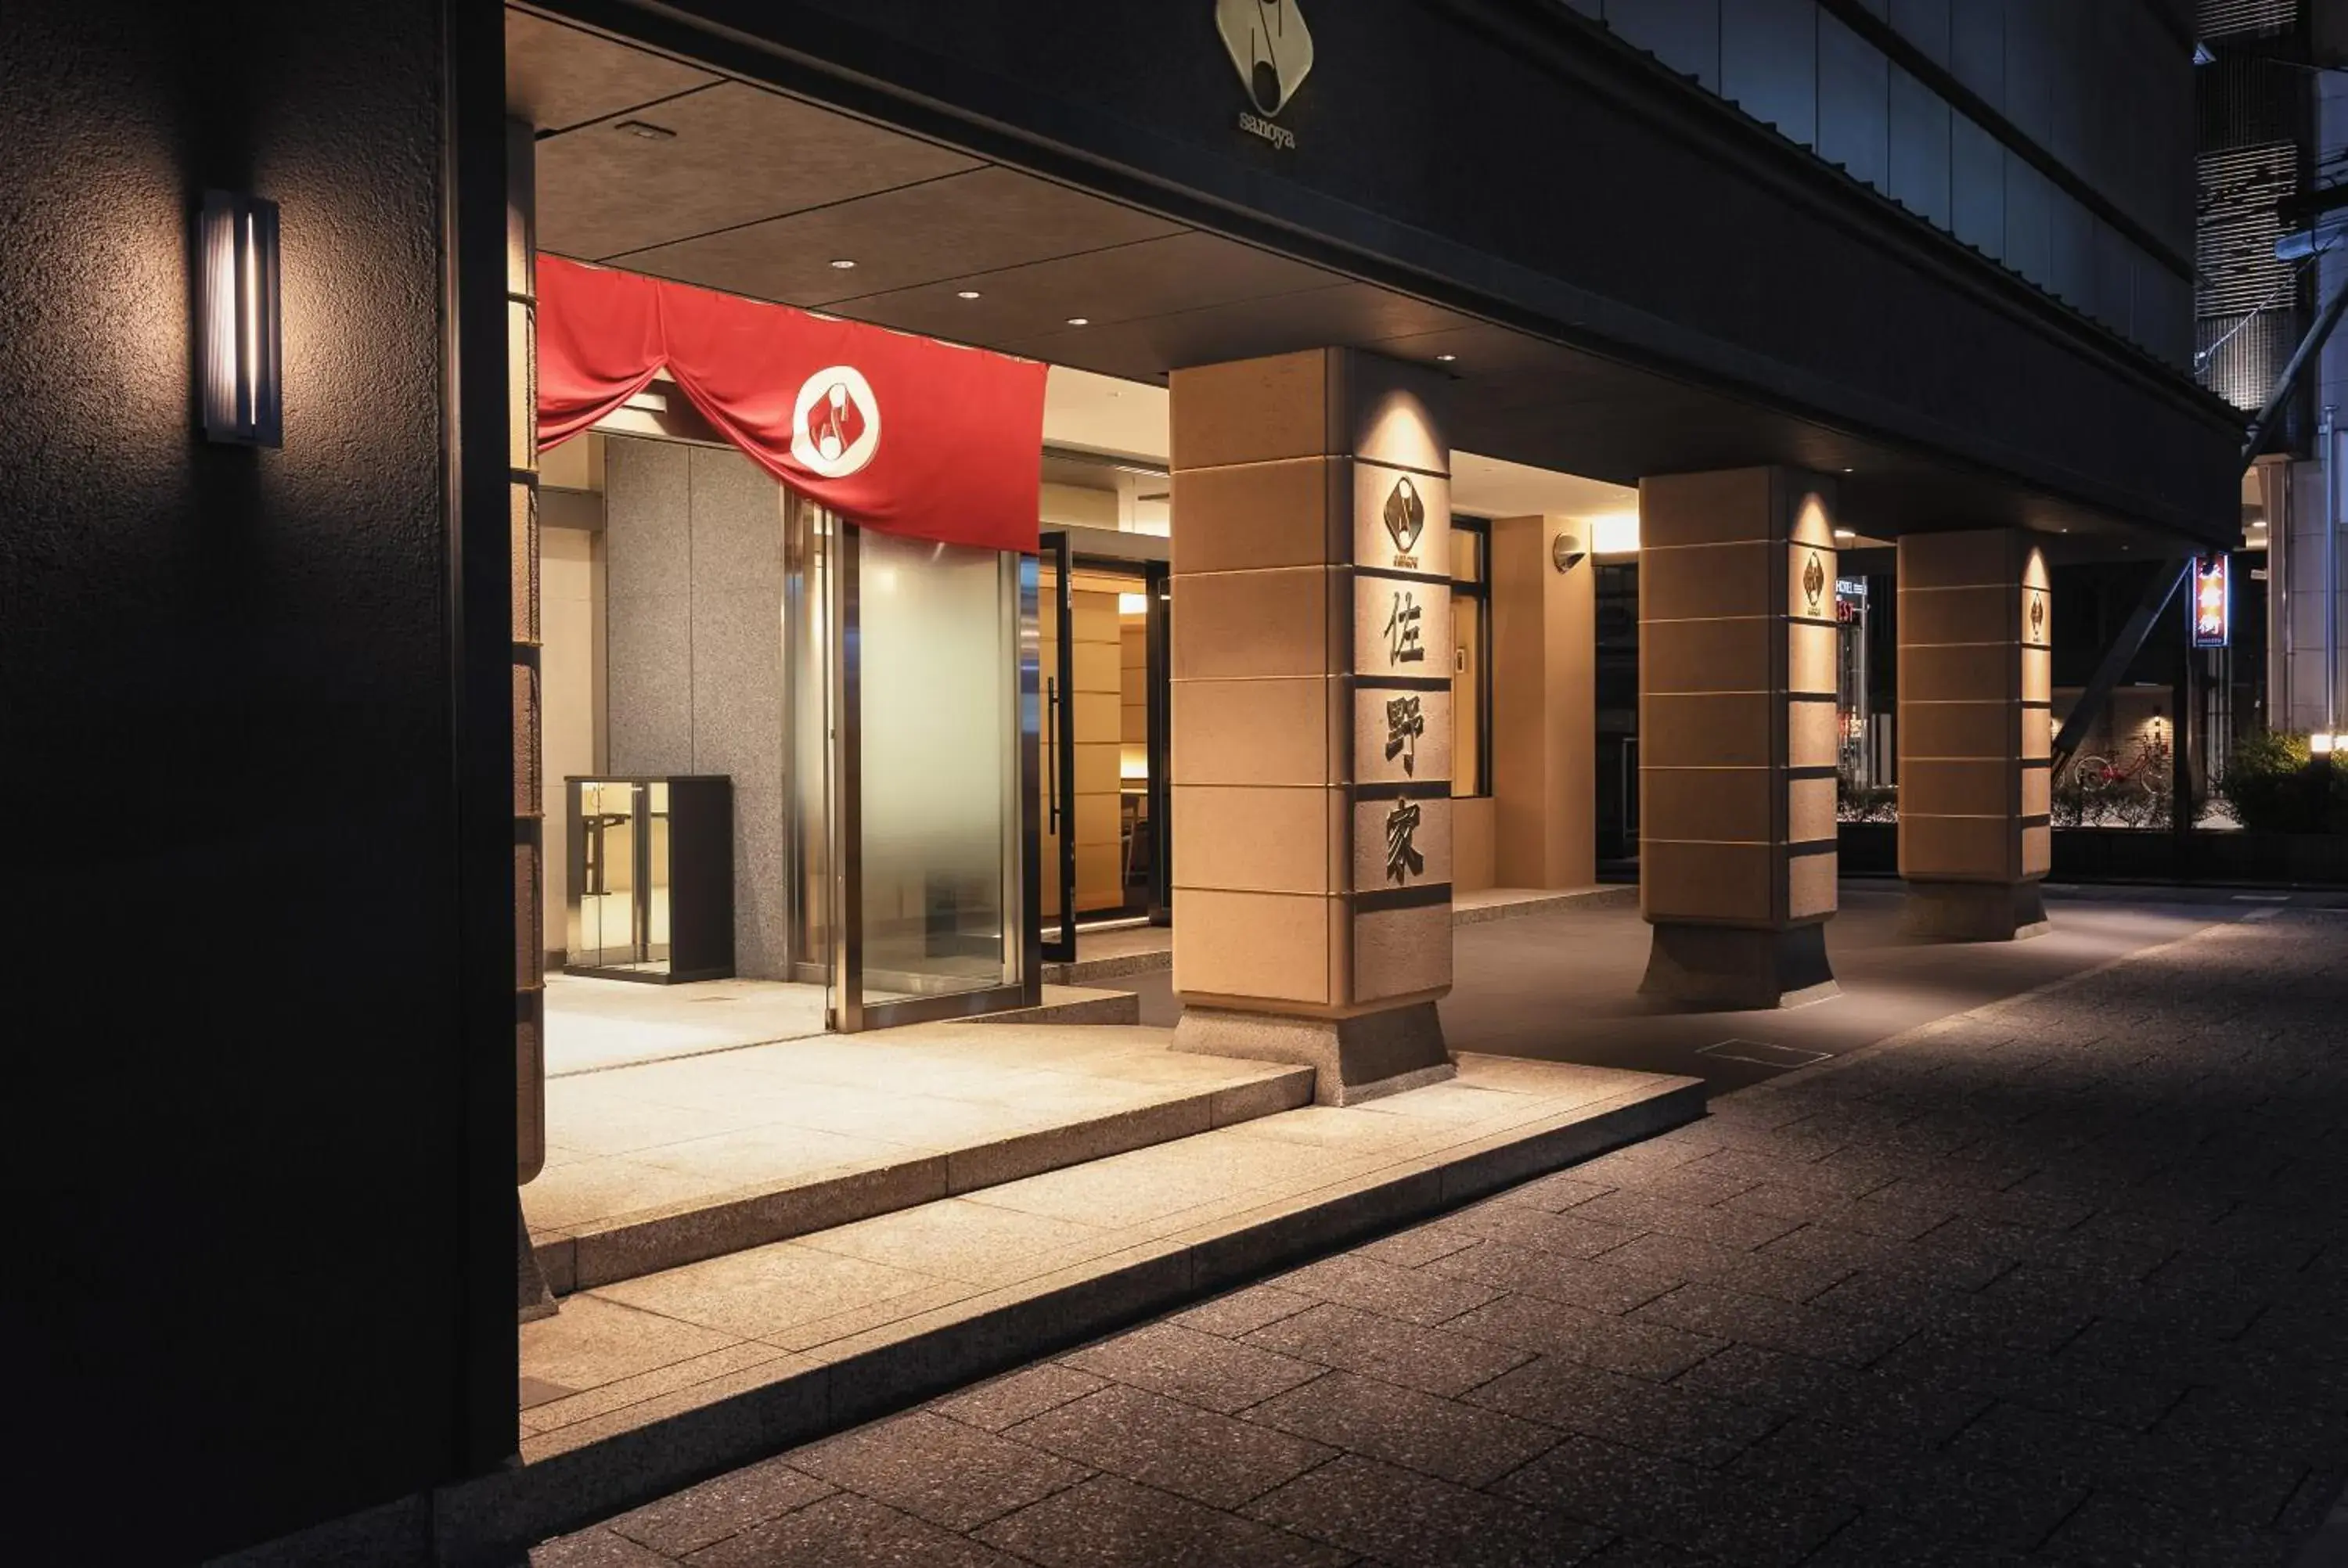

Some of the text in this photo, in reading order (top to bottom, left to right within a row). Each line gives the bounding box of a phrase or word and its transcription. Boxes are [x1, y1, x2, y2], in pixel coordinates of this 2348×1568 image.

[1239, 112, 1295, 149] sanoya
[1384, 592, 1424, 886] 佐野家
